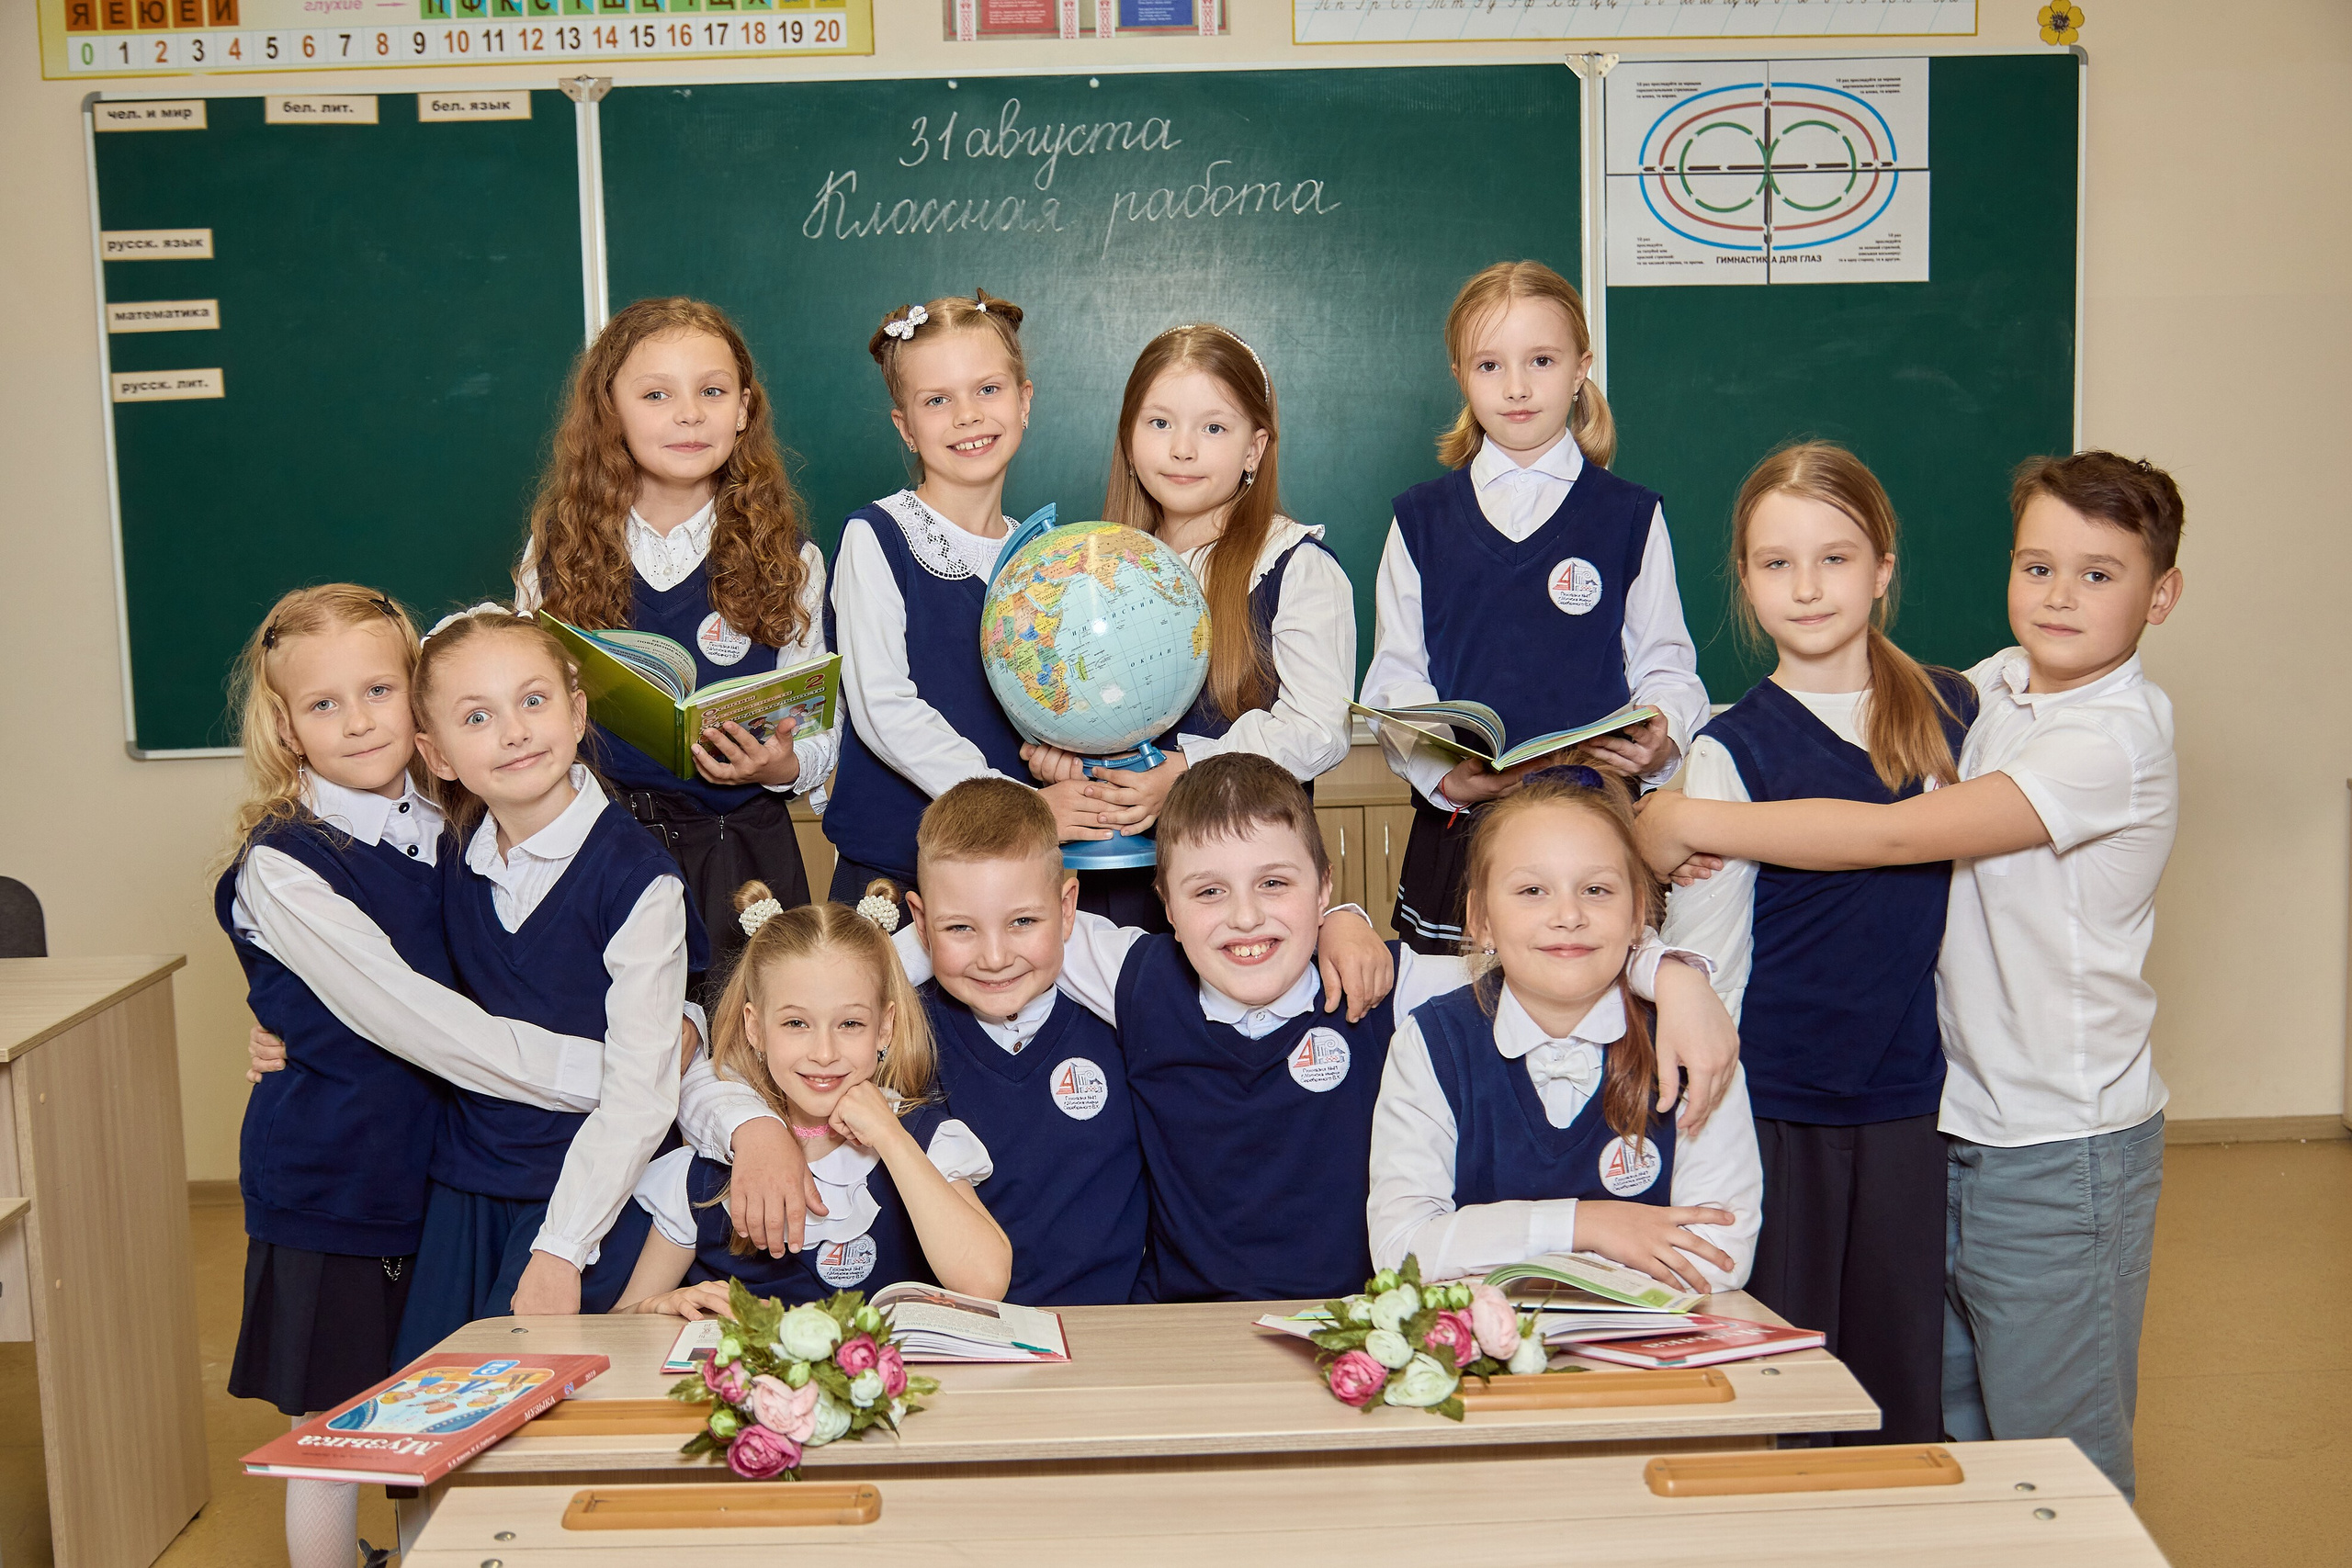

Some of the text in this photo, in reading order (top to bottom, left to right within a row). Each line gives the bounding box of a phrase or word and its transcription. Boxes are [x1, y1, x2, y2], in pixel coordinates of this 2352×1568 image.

[73, 4, 90, 26] Я
[140, 0, 165, 23] Ю
[82, 19, 840, 65] 0 1 2 3 4 5 6 7 8 9 10 11 12 13 14 15 16 17 18 19 20
[107, 106, 193, 120] чел. и мир
[283, 99, 354, 113] бел. лит.
[432, 99, 511, 112] бел. язык
[899, 97, 1182, 191] 31 августа
[801, 159, 1342, 261] Классная работа
[107, 238, 204, 252] русск. язык
[1715, 254, 1822, 265] ГИМНАСТИКА ДЛЯ ГЛАЗ
[114, 307, 209, 321] математика
[121, 378, 209, 393] русск. лит.
[804, 673, 825, 690] 2
[701, 695, 756, 717] Основы
[584, 1370, 597, 1382] 2019
[564, 1382, 575, 1396] 2
[524, 1395, 557, 1422] МУЗЫКА
[298, 1434, 444, 1457] Музыка
